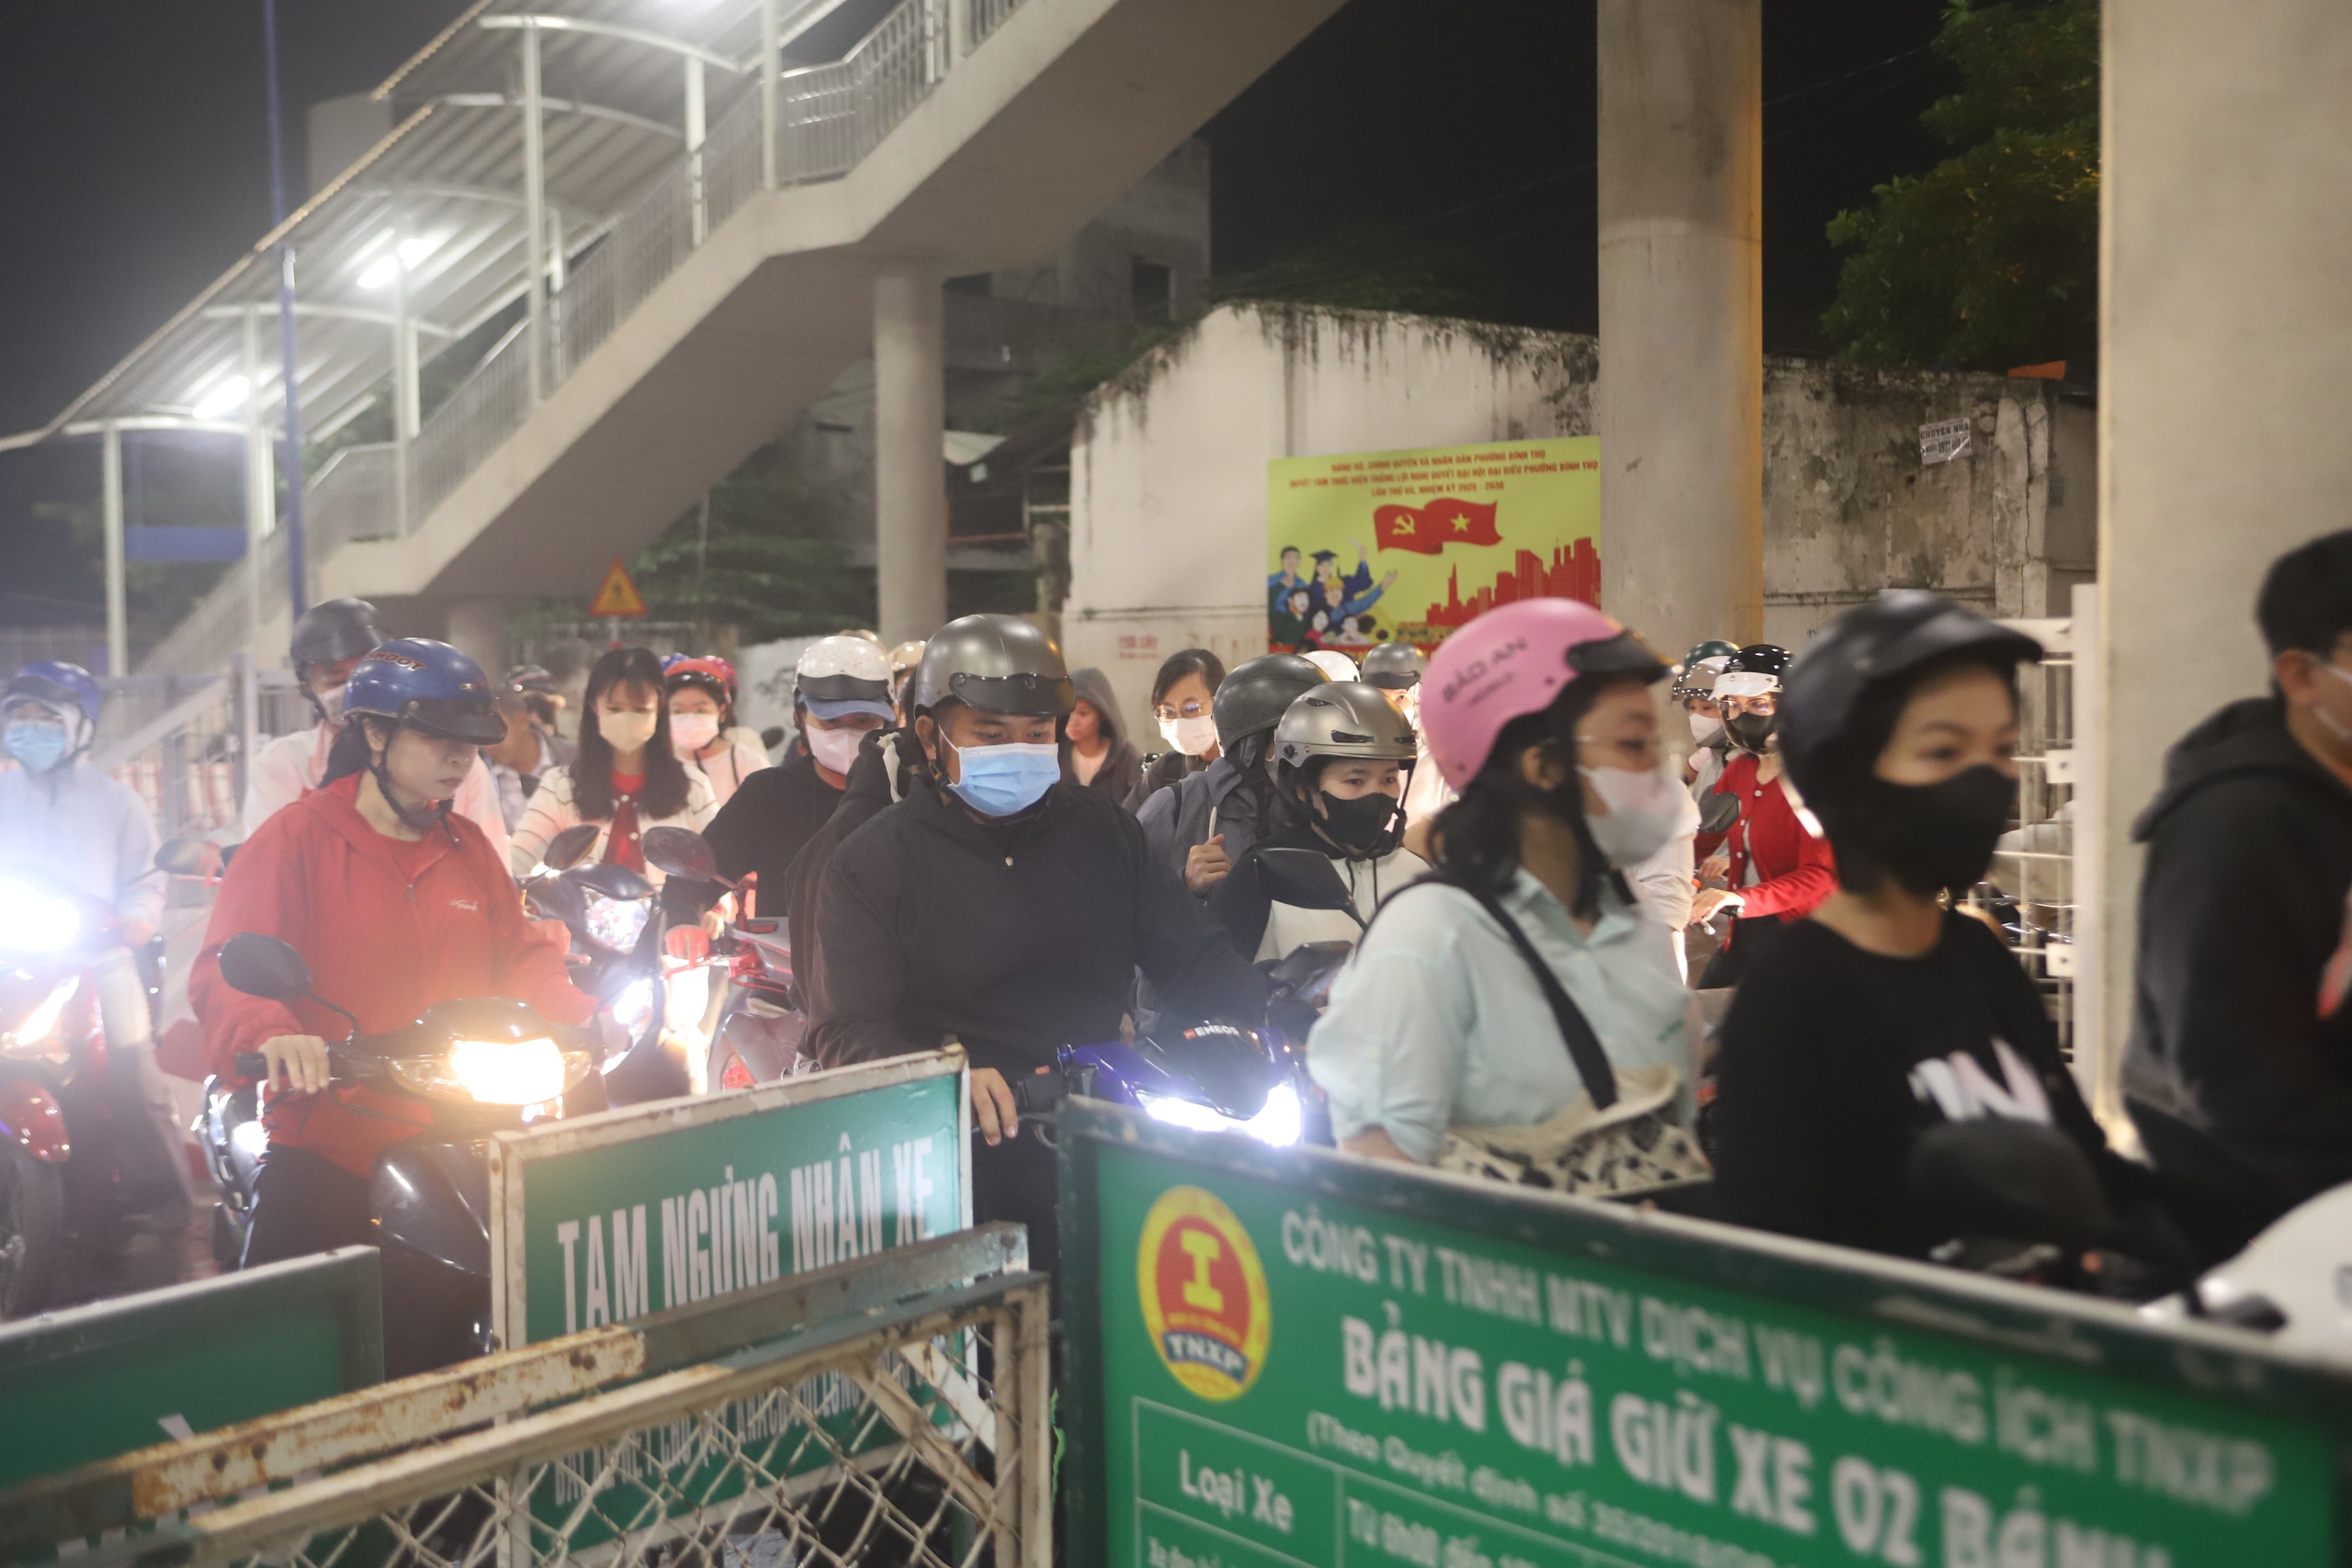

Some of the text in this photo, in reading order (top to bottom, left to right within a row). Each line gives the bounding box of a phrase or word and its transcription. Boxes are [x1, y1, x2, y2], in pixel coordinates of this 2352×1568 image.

[1194, 1024, 1239, 1037] ENEOS
[892, 1135, 936, 1248] XE
[1168, 1332, 1244, 1370] TNXP
[1281, 1201, 1378, 1284] CÔNG
[1380, 1232, 1428, 1297] TY
[1433, 1245, 1544, 1327] TNHH
[1544, 1271, 1634, 1348] MTV
[1639, 1296, 1750, 1382] DỊCH
[1752, 1323, 1826, 1412] VỤ
[1833, 1337, 1988, 1446] CÔNG
[1994, 1362, 2099, 1473] ÍCH
[1340, 1298, 1487, 1435] BẢNG
[1496, 1357, 1595, 1467] GIÁ
[1610, 1388, 1720, 1507] GIỮ
[1727, 1422, 1817, 1537] XE
[1832, 1454, 1923, 1568] 02
[1179, 1447, 1295, 1535] Loại Xe
